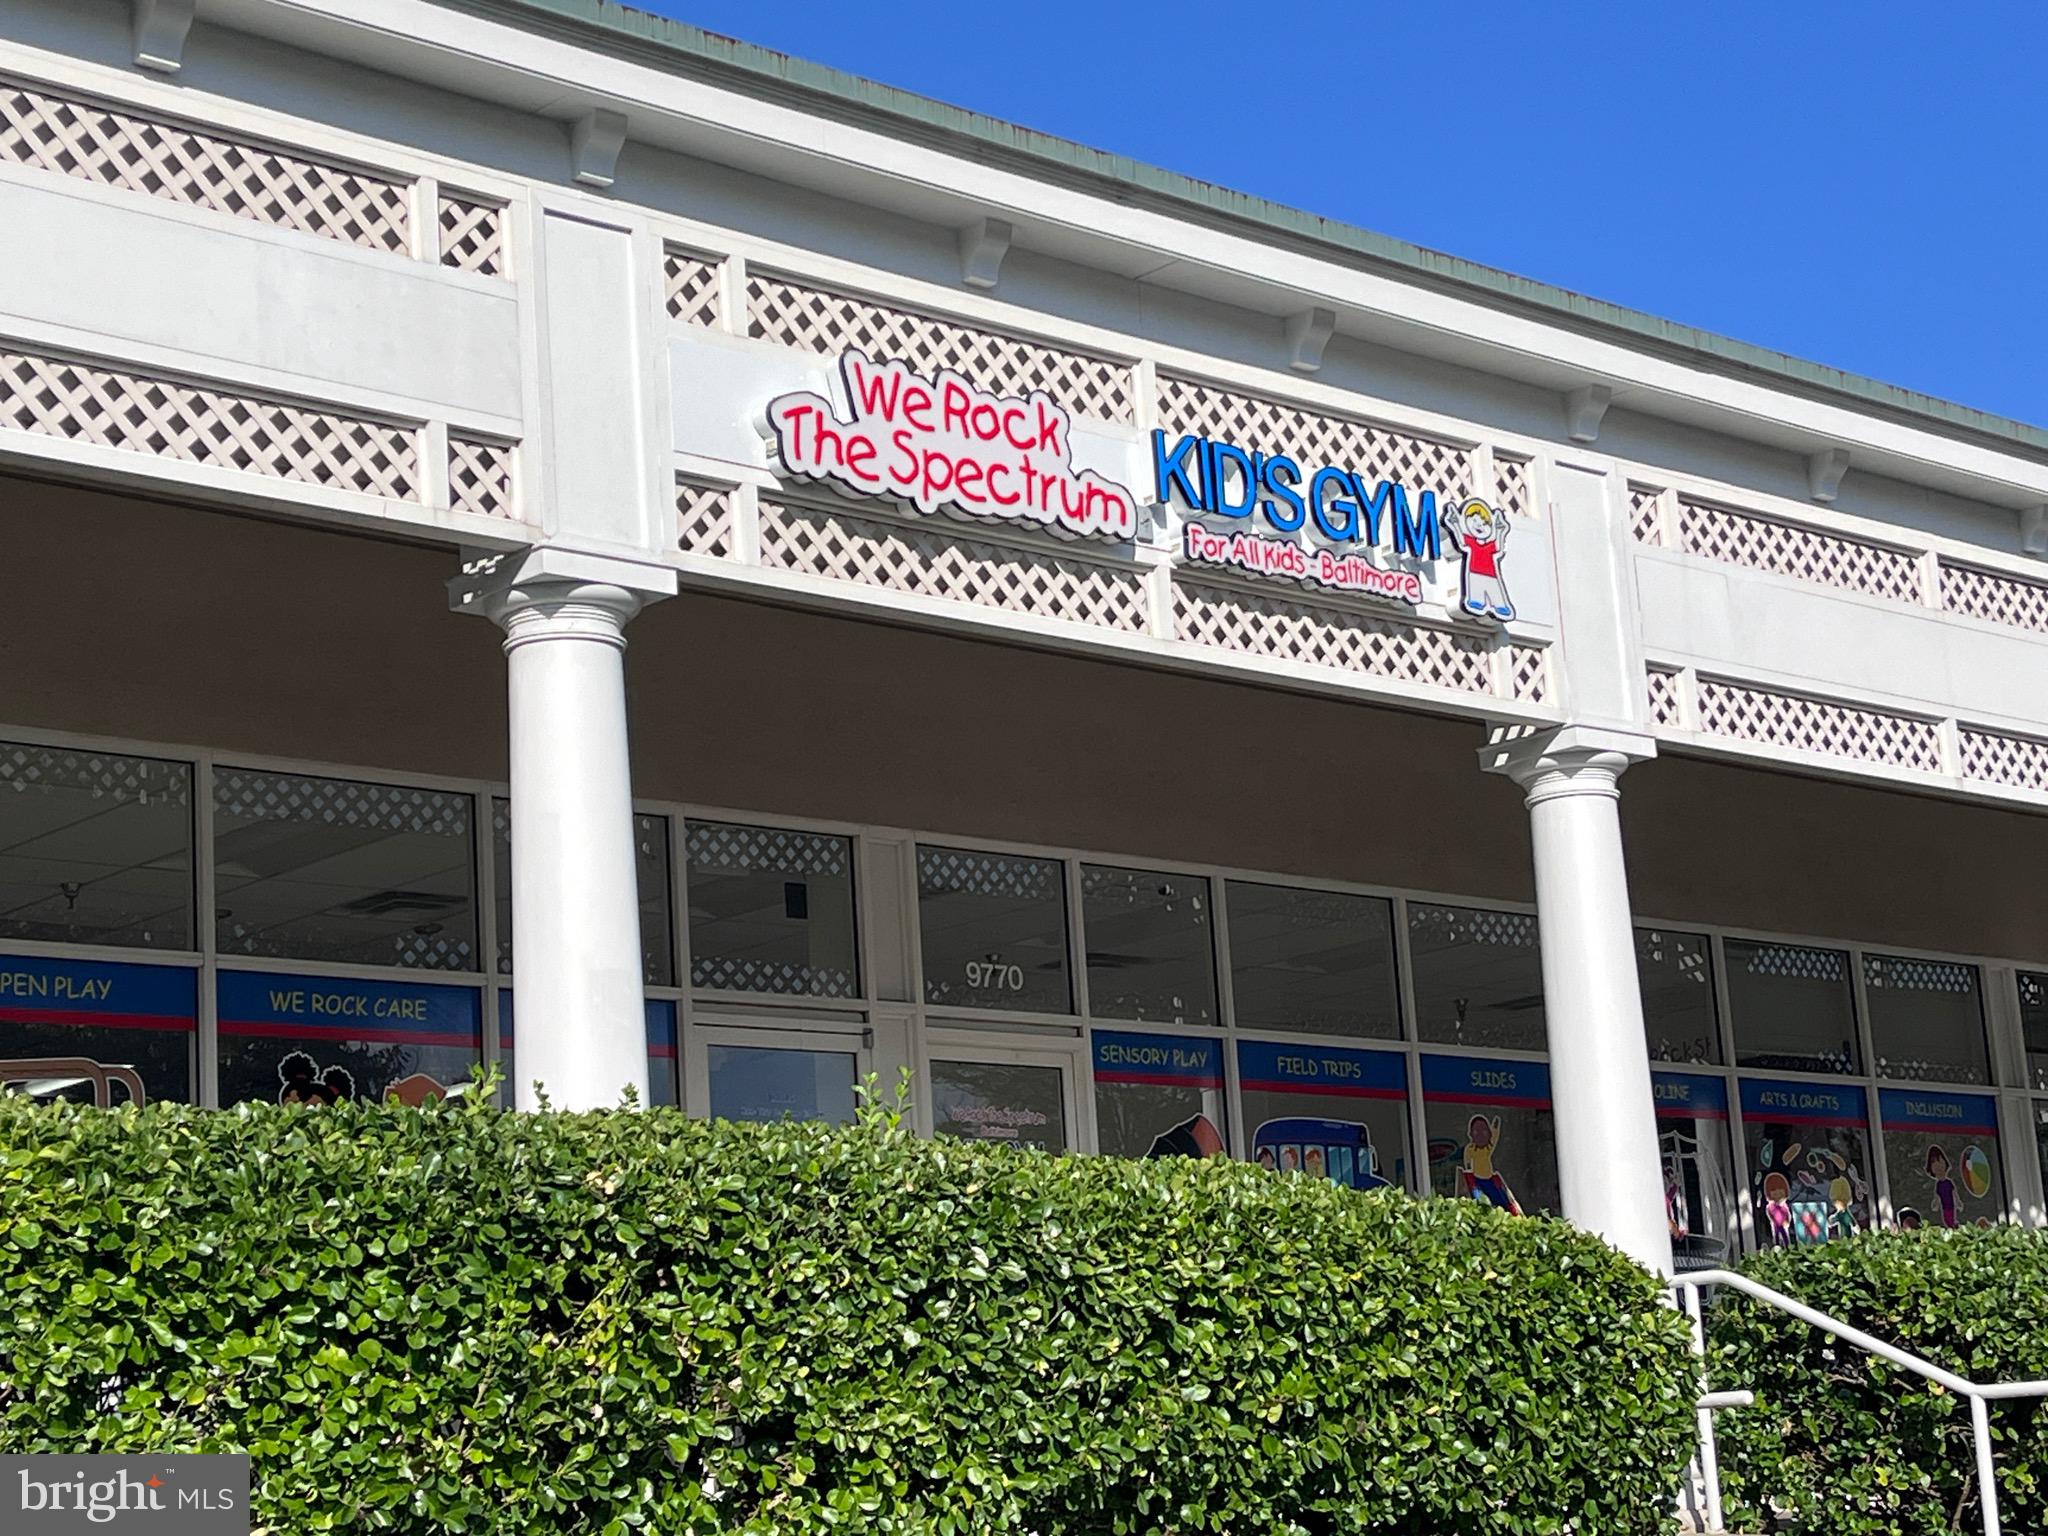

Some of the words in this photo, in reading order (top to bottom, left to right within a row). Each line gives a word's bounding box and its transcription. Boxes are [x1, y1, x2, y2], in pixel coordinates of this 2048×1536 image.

[853, 361, 936, 432] We
[943, 380, 1061, 456] Rock
[783, 406, 880, 483] The
[888, 429, 1127, 528] Spectrum
[1150, 428, 1306, 532] KID'S
[1310, 466, 1442, 561] GYM
[1189, 528, 1226, 558] For
[1232, 538, 1260, 565] All
[1263, 543, 1305, 574] Kids
[1321, 554, 1420, 598] Baltimore
[0, 972, 47, 996] PEN
[54, 976, 112, 1000] PLAY
[965, 961, 1024, 990] 9770
[269, 990, 304, 1013] WE
[311, 993, 369, 1016] ROCK
[374, 998, 427, 1020] CARE
[1100, 1044, 1169, 1066] SENSORY
[1173, 1048, 1208, 1068] PLAY
[1277, 1055, 1318, 1077] FIELD
[1321, 1060, 1362, 1079] TRIPS
[1470, 1070, 1517, 1089] SLIDES
[1654, 1084, 1690, 1101] OLINE
[1760, 1091, 1788, 1107] ARTS
[1789, 1094, 1798, 1108] &
[1799, 1094, 1840, 1111] CRAFTS
[1905, 1101, 1963, 1118] INCLUSION
